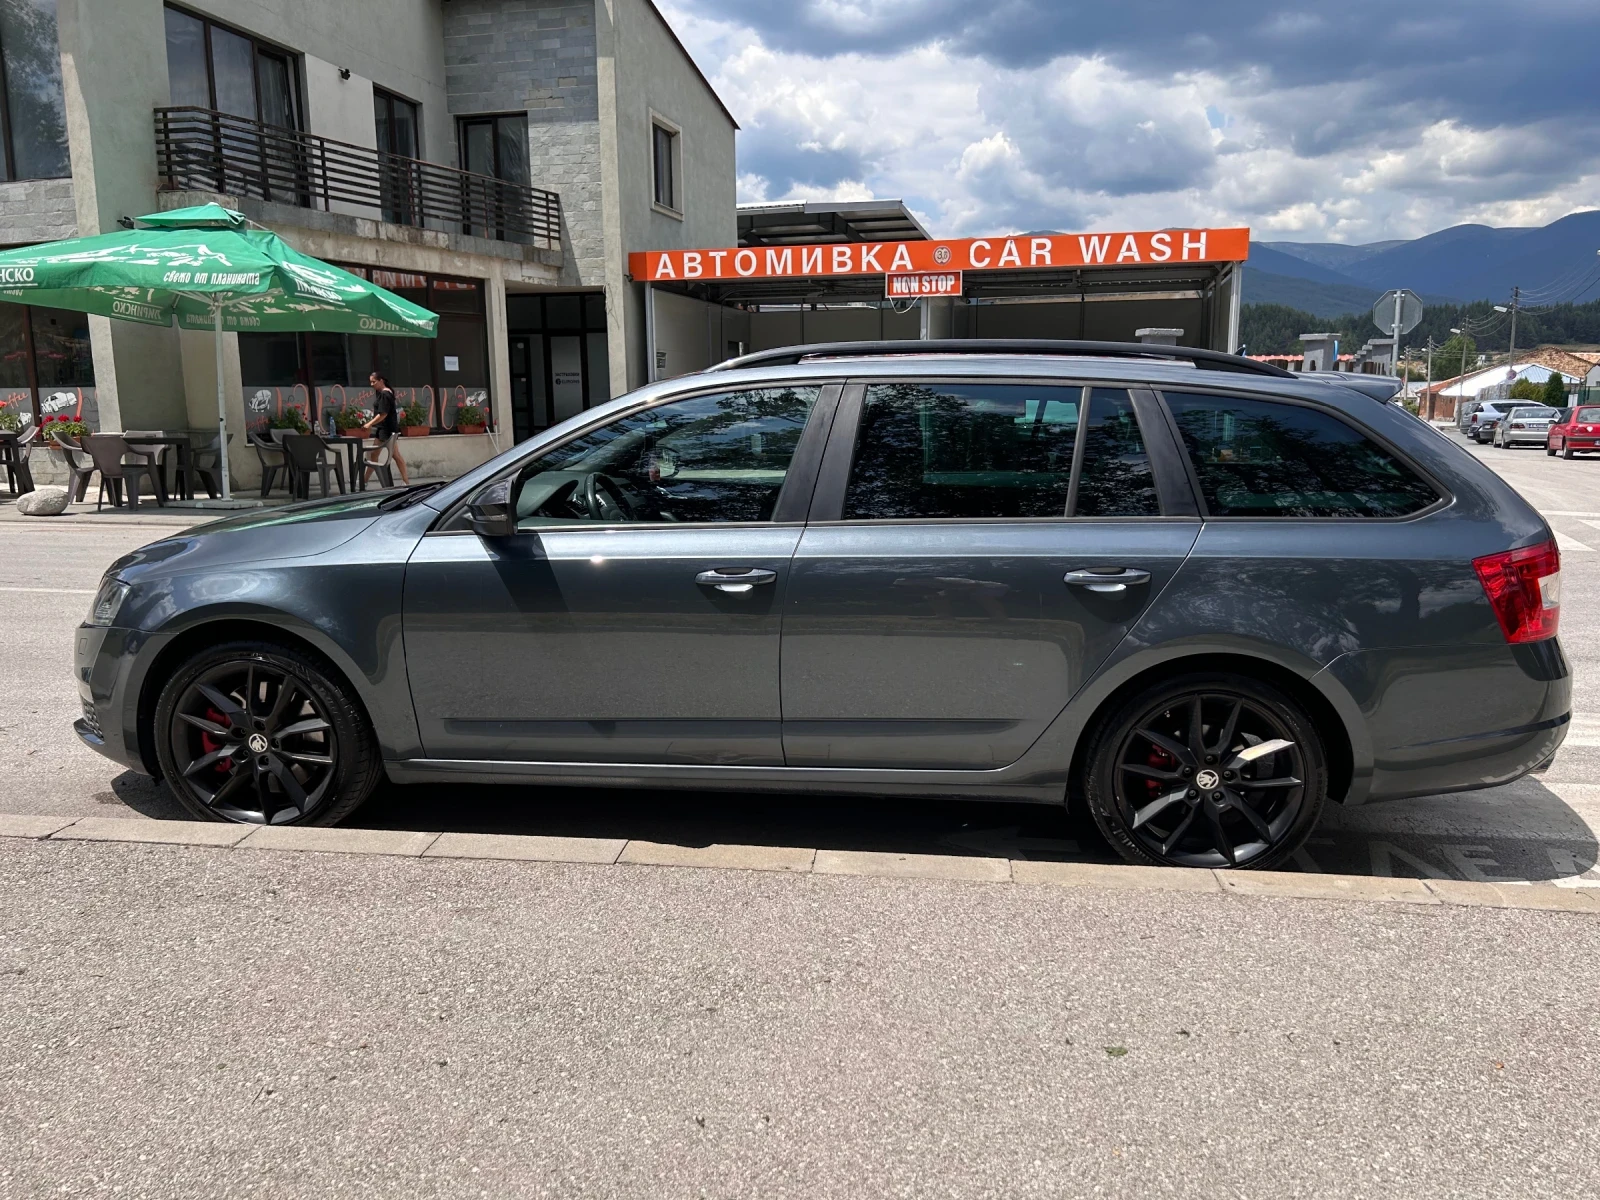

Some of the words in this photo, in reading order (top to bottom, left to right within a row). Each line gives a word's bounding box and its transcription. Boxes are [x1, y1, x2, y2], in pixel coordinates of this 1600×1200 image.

[654, 244, 914, 279] АВТОМИВКА
[969, 238, 1052, 268] CAR
[1078, 231, 1207, 264] WASH
[163, 270, 192, 284] свежо
[194, 272, 209, 285] от
[892, 275, 919, 294] NON
[921, 273, 956, 293] STOP
